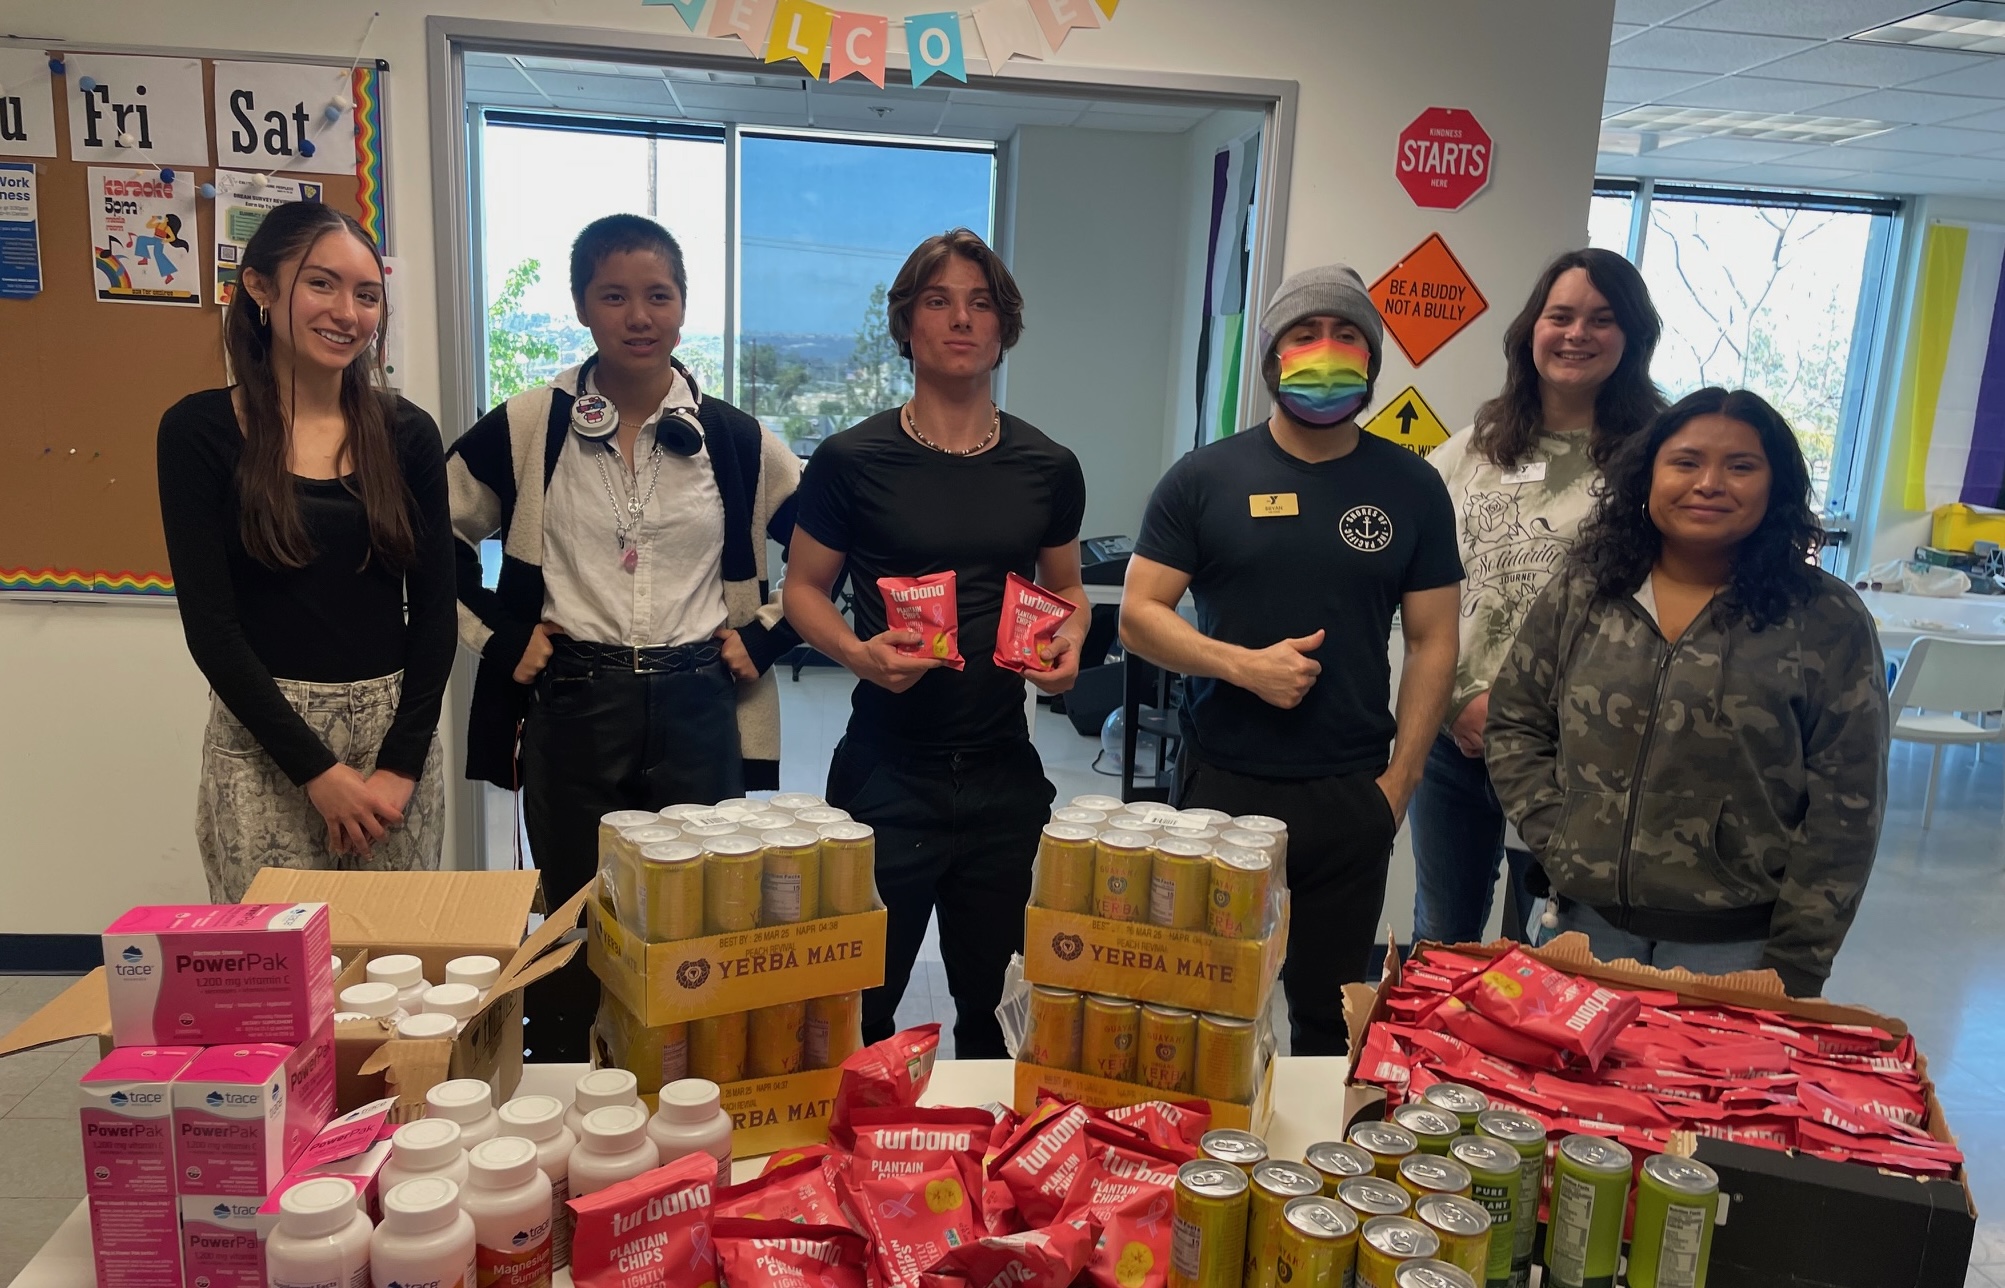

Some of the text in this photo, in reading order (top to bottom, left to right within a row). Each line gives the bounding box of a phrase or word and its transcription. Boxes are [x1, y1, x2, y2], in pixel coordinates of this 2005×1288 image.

[684, 0, 1077, 66] ELCOE
[80, 84, 153, 149] Fri
[230, 89, 309, 157] Sat
[1429, 128, 1462, 138] KINDNESS
[1401, 139, 1486, 177] STARTS
[104, 176, 174, 199] karaoke
[1430, 178, 1448, 188] HERE
[105, 197, 138, 217] 5pm
[1389, 279, 1467, 301] BE A BUDDY
[1384, 298, 1466, 321] NOT A BULLY
[1345, 508, 1388, 525] SHORES OF
[1344, 528, 1389, 549] THE PACIFIC
[1472, 544, 1562, 583] Solidarity
[1499, 572, 1537, 585] JOURNEY
[890, 583, 945, 602] turbana
[1019, 589, 1065, 618] turbana
[1016, 617, 1032, 627] CHIPS
[1095, 898, 1140, 916] YERBA
[719, 921, 839, 948] BEST BY 26 MAR 25 NAPR 04:38
[769, 942, 797, 954] REVIVAL
[115, 963, 152, 976] trace
[176, 952, 289, 974] PowerPak
[717, 940, 864, 979] YERBA MATE
[1090, 944, 1234, 984] YERBA MATE
[225, 979, 241, 988] mg
[244, 977, 281, 986] vitamin
[284, 975, 290, 984] C
[129, 1092, 162, 1103] trace
[225, 1092, 257, 1104] trace
[732, 1087, 745, 1096] MAR
[731, 1107, 779, 1131] RBA
[87, 1123, 164, 1138] PowerPak
[181, 1123, 259, 1138] PowerPak
[308, 1125, 375, 1152] PowerPak
[874, 1127, 971, 1152] turbana
[1016, 1106, 1089, 1176] turbana
[871, 1160, 924, 1174] PLANTAIN
[1040, 1153, 1081, 1196] PLANTAIN
[1102, 1145, 1177, 1190] turban
[1090, 1177, 1140, 1195] PLANTAIN
[1475, 1187, 1503, 1196] PURE
[1092, 1192, 1128, 1204] CHIPS
[1477, 1201, 1508, 1210] LANT
[610, 1184, 711, 1238] turbana
[609, 1231, 669, 1262] PLANTAIN
[618, 1247, 664, 1273] CHIPS
[622, 1267, 665, 1288] LIGHTLY
